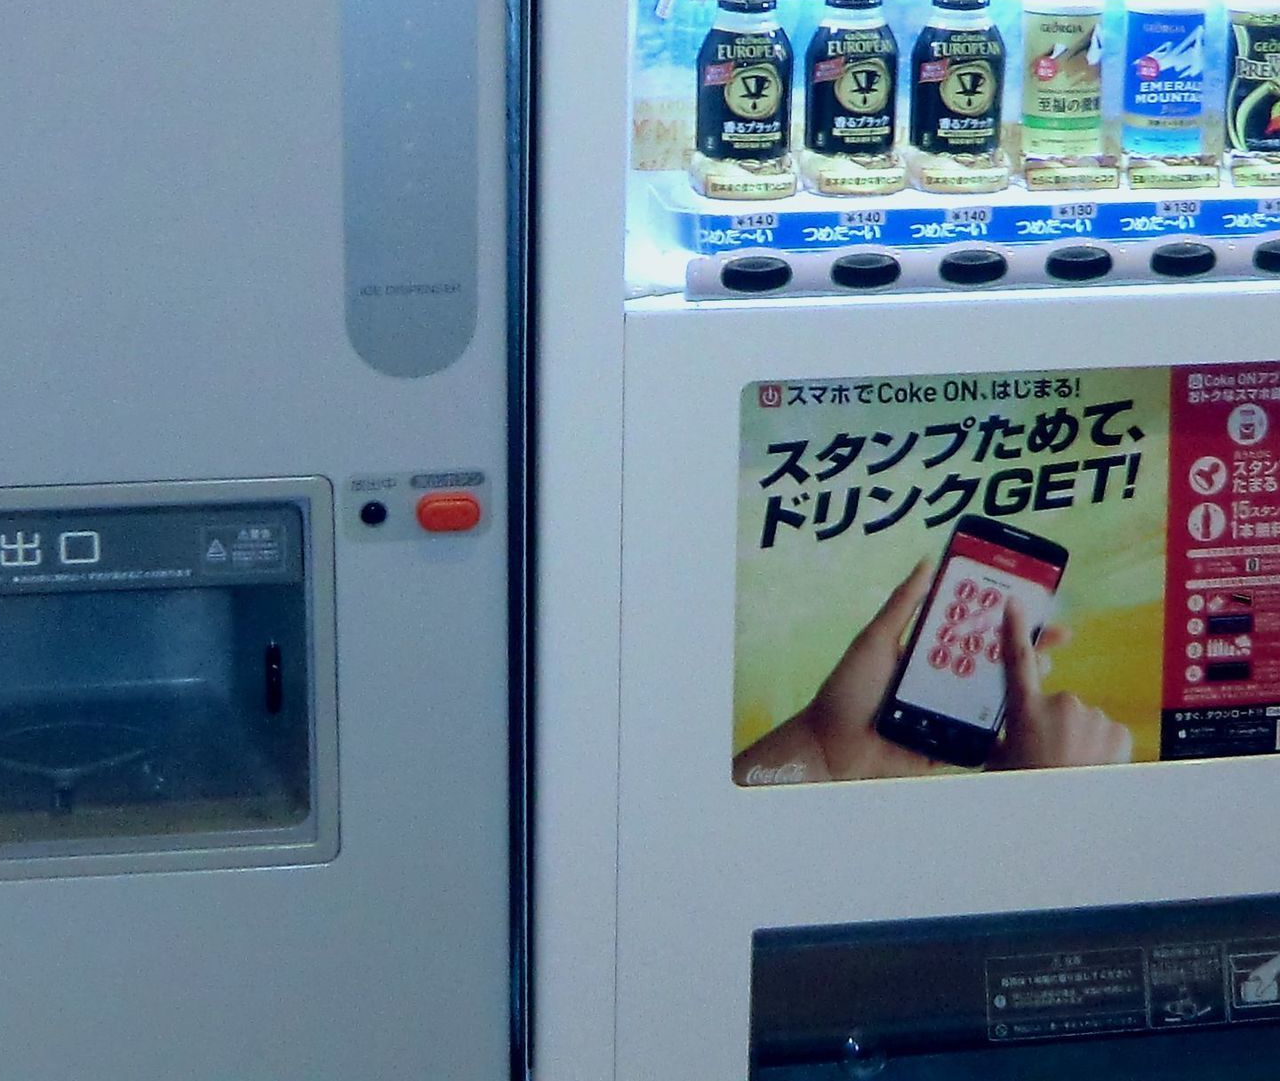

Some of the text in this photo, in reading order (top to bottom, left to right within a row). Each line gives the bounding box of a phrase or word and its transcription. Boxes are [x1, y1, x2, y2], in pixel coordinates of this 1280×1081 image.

[1040, 23, 1084, 33] GEORGIA
[1135, 93, 1201, 104] MOUNTA
[788, 382, 937, 406] スマホでCoke
[759, 400, 1145, 489] スタンプためて、
[1232, 477, 1278, 494] たまる
[760, 452, 1142, 548] ドリンクGET!
